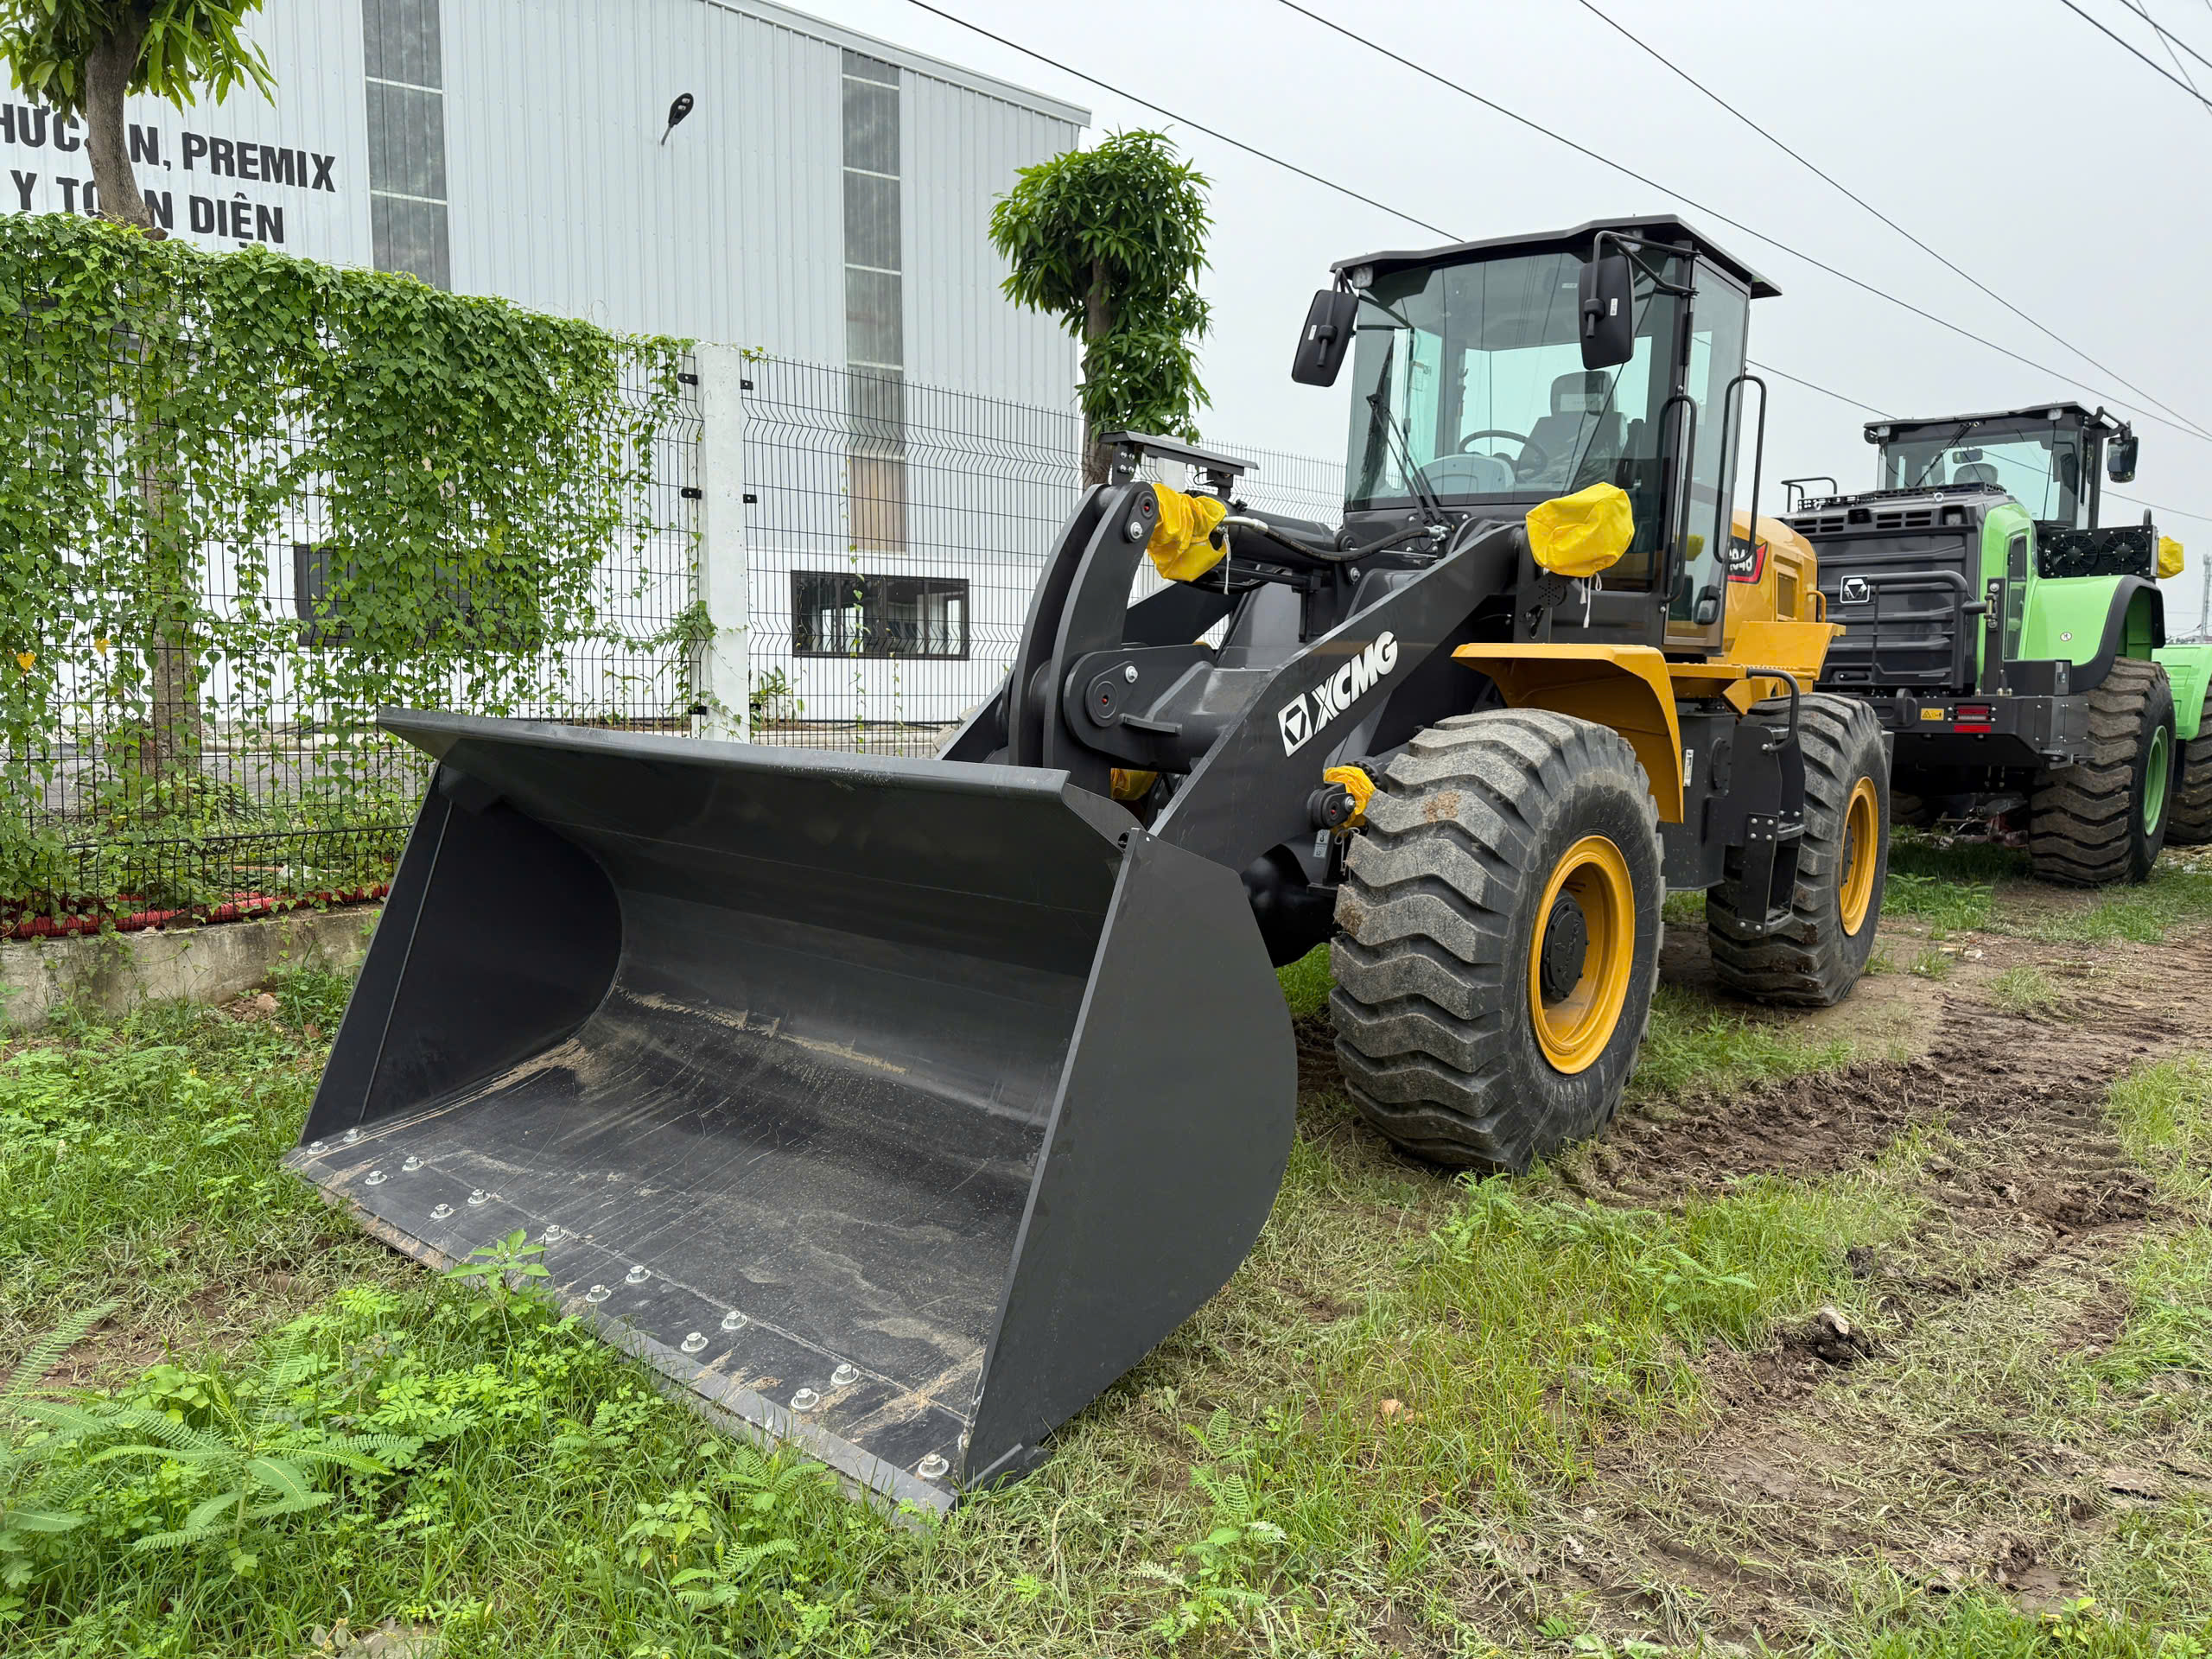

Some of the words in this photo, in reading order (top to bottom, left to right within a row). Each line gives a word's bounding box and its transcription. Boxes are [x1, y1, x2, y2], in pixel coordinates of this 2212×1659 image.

[128, 124, 172, 171] N,
[181, 131, 336, 193] PREMIX
[10, 169, 37, 211] Y
[56, 176, 174, 230] TON
[189, 192, 284, 249] DIỆN
[1311, 631, 1398, 735] XCMG
